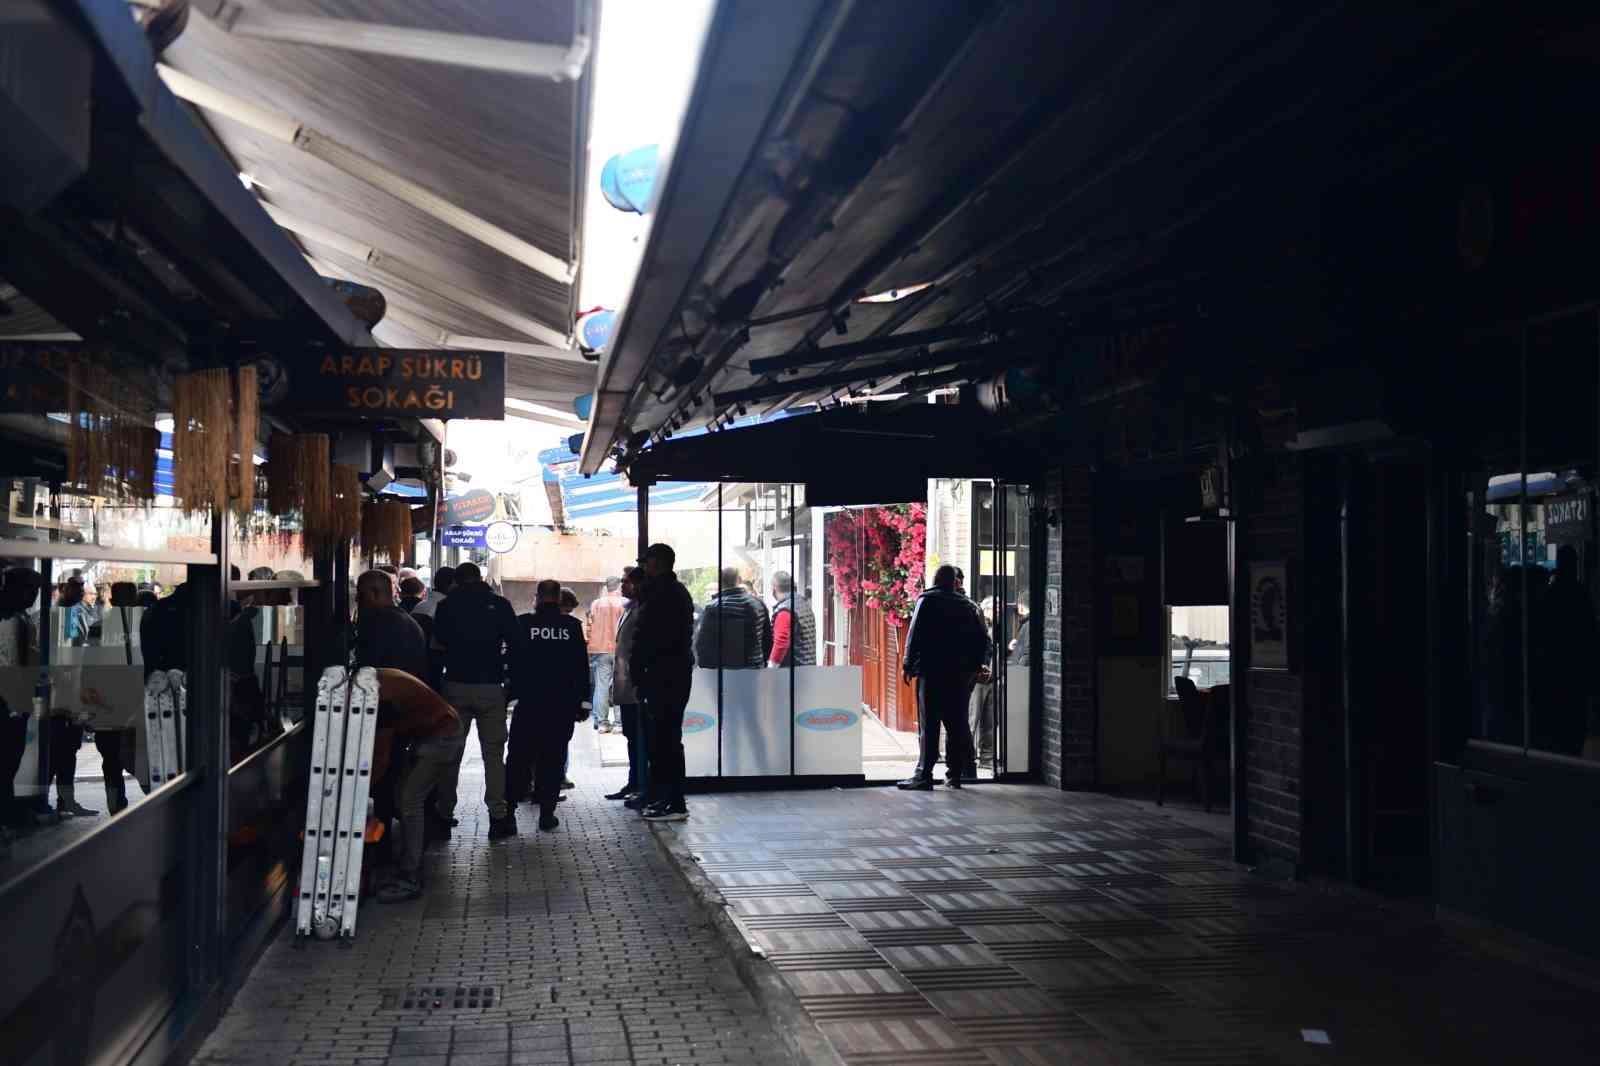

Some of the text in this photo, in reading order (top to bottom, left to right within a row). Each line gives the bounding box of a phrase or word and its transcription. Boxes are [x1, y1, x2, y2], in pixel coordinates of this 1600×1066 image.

[320, 352, 482, 381] ARAP ŞÜKRÜ
[347, 385, 454, 410] SOKAĞI
